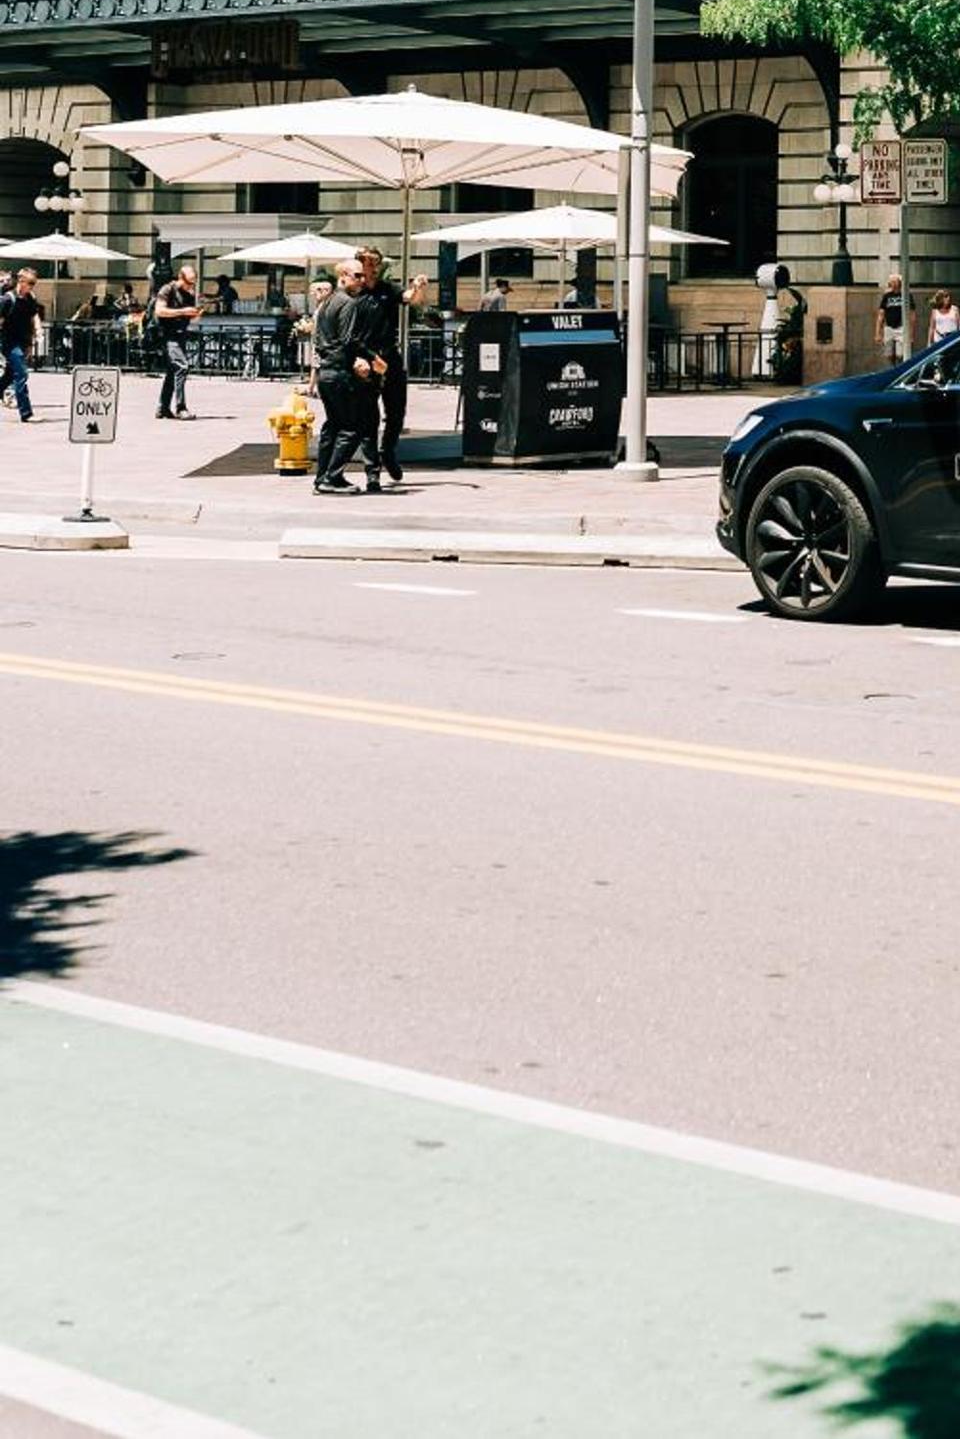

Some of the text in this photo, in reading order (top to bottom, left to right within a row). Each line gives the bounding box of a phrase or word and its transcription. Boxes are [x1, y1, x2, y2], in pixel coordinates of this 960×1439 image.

[872, 144, 889, 157] NO
[552, 315, 583, 329] VALET
[76, 401, 112, 416] ONLY
